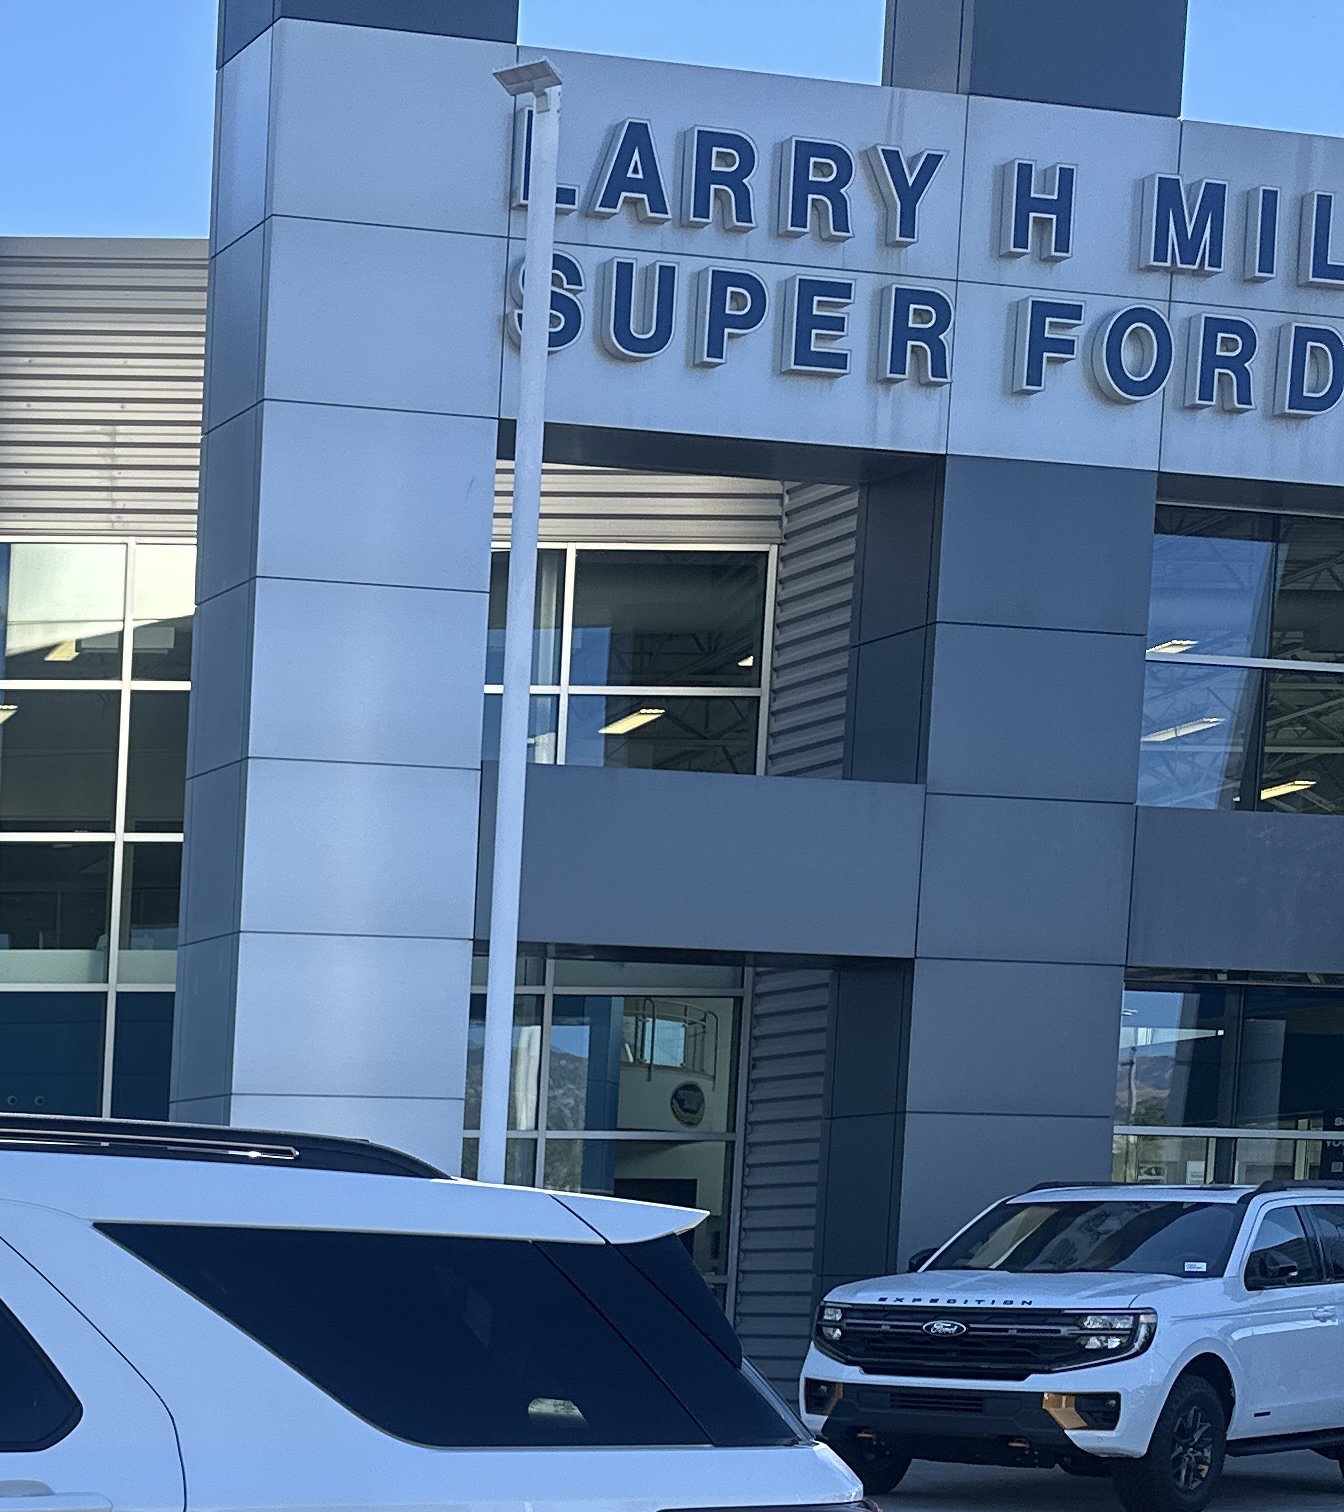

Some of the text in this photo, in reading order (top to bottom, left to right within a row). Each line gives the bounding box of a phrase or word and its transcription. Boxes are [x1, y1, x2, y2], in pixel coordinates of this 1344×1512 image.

[513, 106, 950, 247] LARRY
[1000, 158, 1078, 261] H
[508, 249, 1344, 418] SUPER FORD
[878, 1297, 1033, 1306] EXPEDITION
